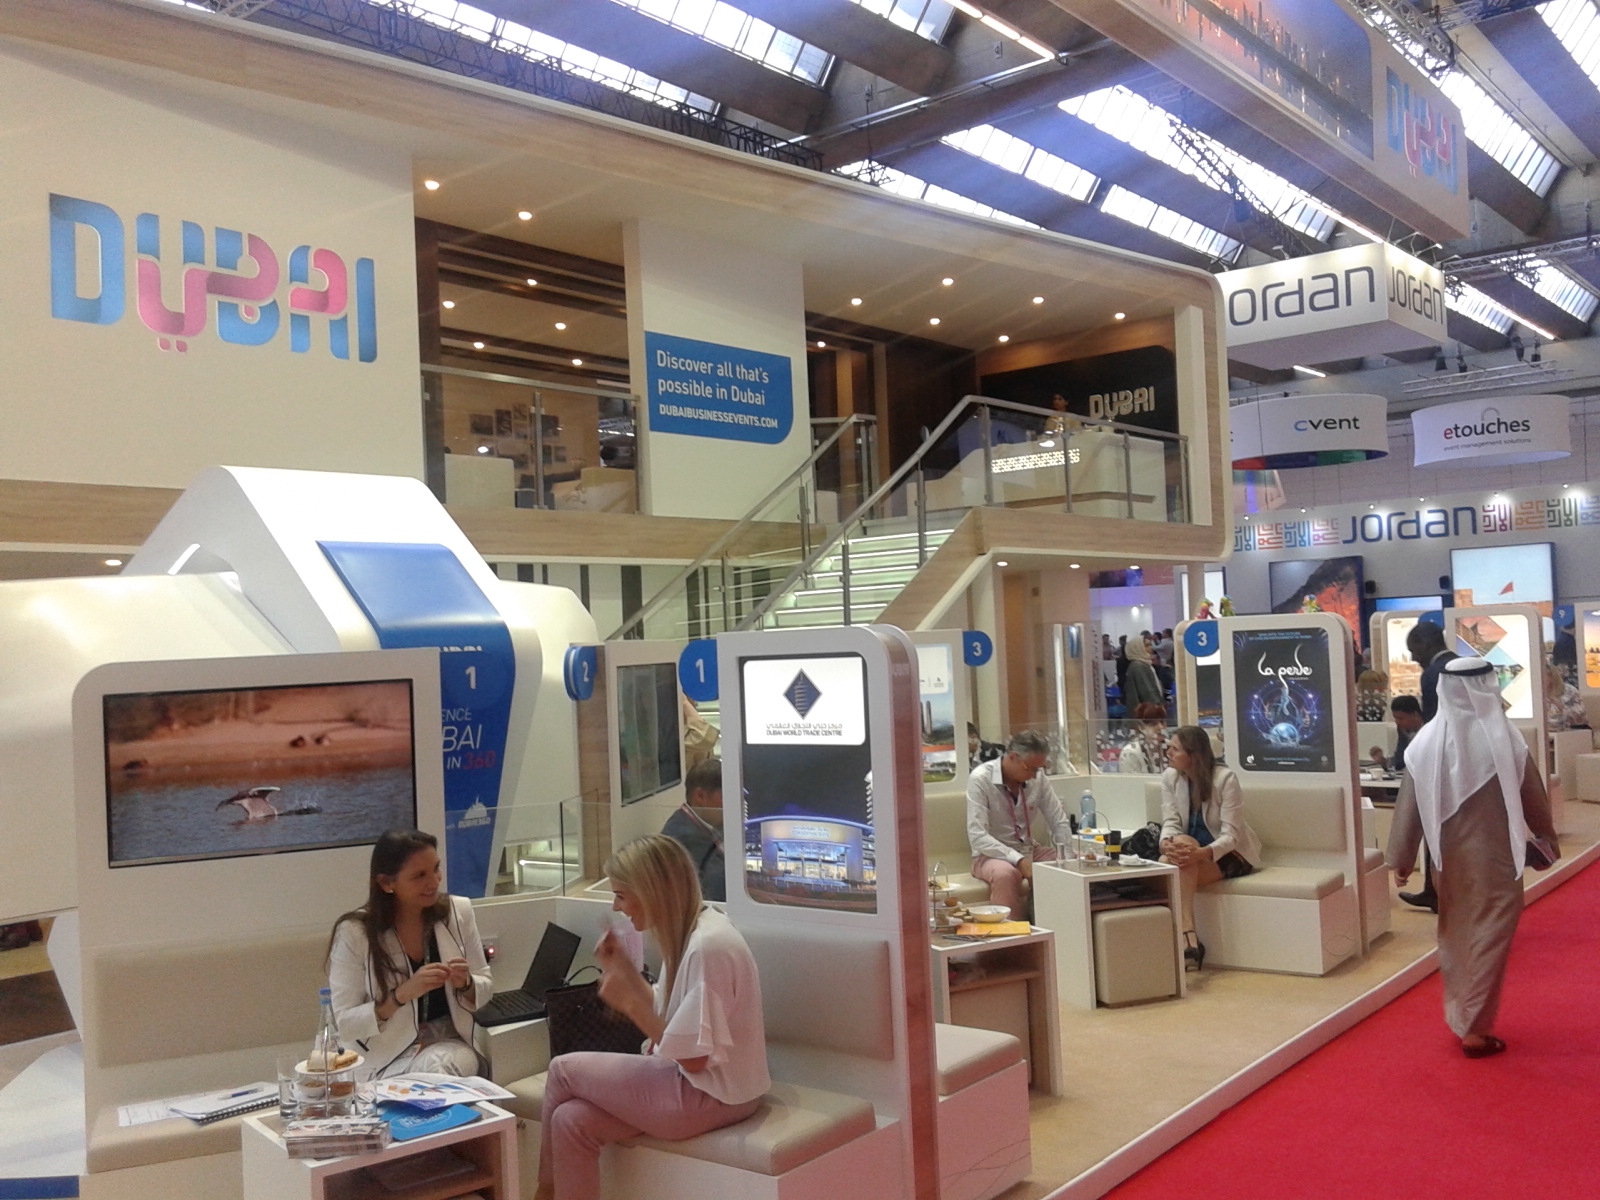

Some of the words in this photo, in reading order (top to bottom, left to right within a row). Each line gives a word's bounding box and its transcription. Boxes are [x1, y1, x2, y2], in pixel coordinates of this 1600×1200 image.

[49, 193, 378, 363] DUBAI
[1229, 265, 1375, 327] ordan
[656, 349, 713, 375] Discover
[716, 361, 734, 378] all
[736, 364, 769, 384] that's
[658, 378, 713, 398] possible
[716, 383, 728, 400] in
[731, 385, 765, 406] Dubai
[659, 403, 778, 429] DUBAIBUSINESSEVENTS.COM
[1294, 416, 1360, 432] cvent
[1443, 417, 1531, 440] etouches
[1460, 440, 1502, 448] management
[972, 641, 982, 657] 3
[1197, 631, 1208, 647] 3
[465, 666, 477, 690] 1
[582, 660, 590, 682] 2
[695, 658, 705, 683] 1
[441, 708, 472, 723] ENCE
[442, 724, 483, 752] BAI
[447, 756, 462, 769] IN
[463, 750, 496, 770] 360
